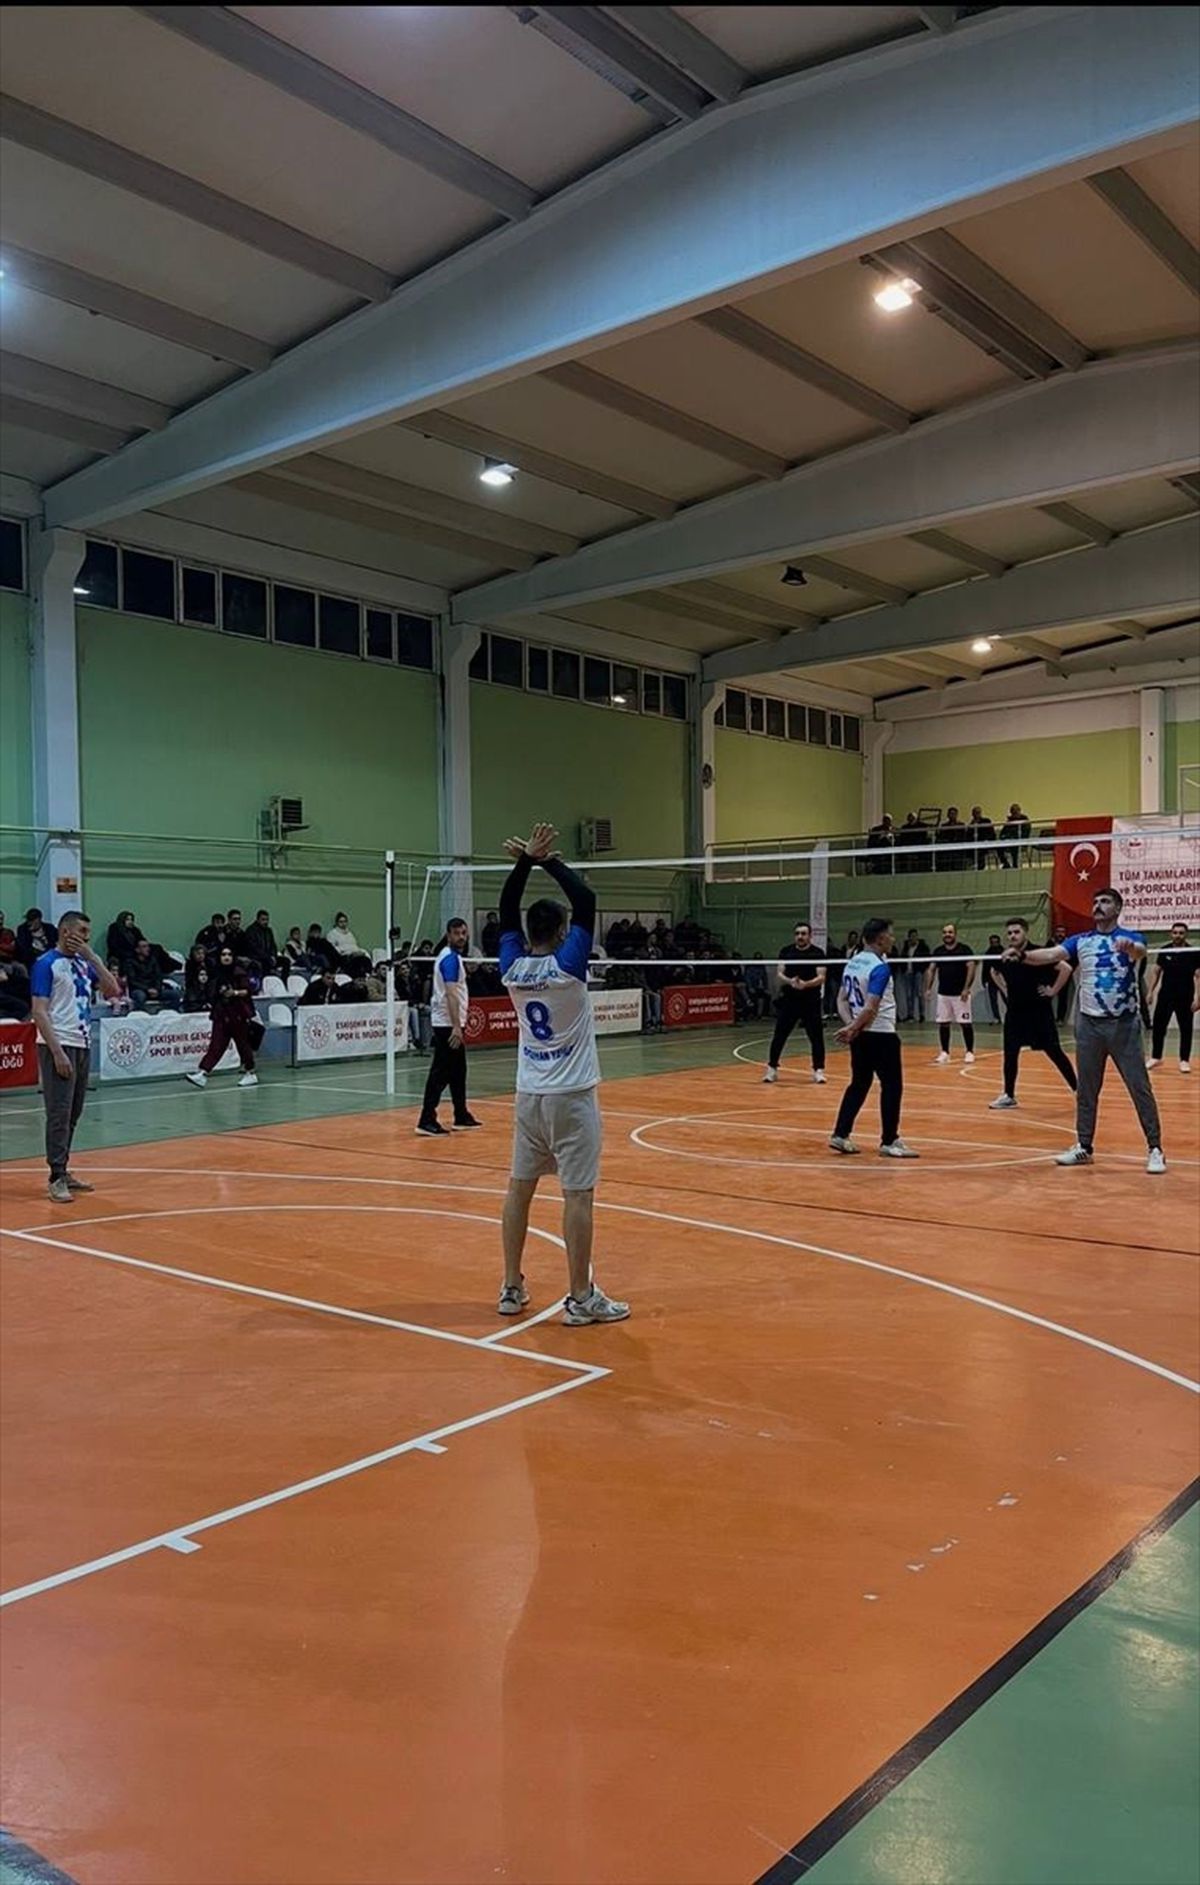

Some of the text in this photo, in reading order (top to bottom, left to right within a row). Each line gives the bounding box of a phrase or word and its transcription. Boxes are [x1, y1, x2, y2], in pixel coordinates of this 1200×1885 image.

[1119, 869, 1140, 880] TÜM
[1124, 894, 1200, 909] AŞARILAR DİLE
[525, 1001, 553, 1040] 8
[150, 1031, 212, 1045] ESKİŞEHİR GENÇ
[336, 1032, 353, 1041] SPOR
[11, 1043, 24, 1054] VE
[150, 1047, 172, 1057] SPOR
